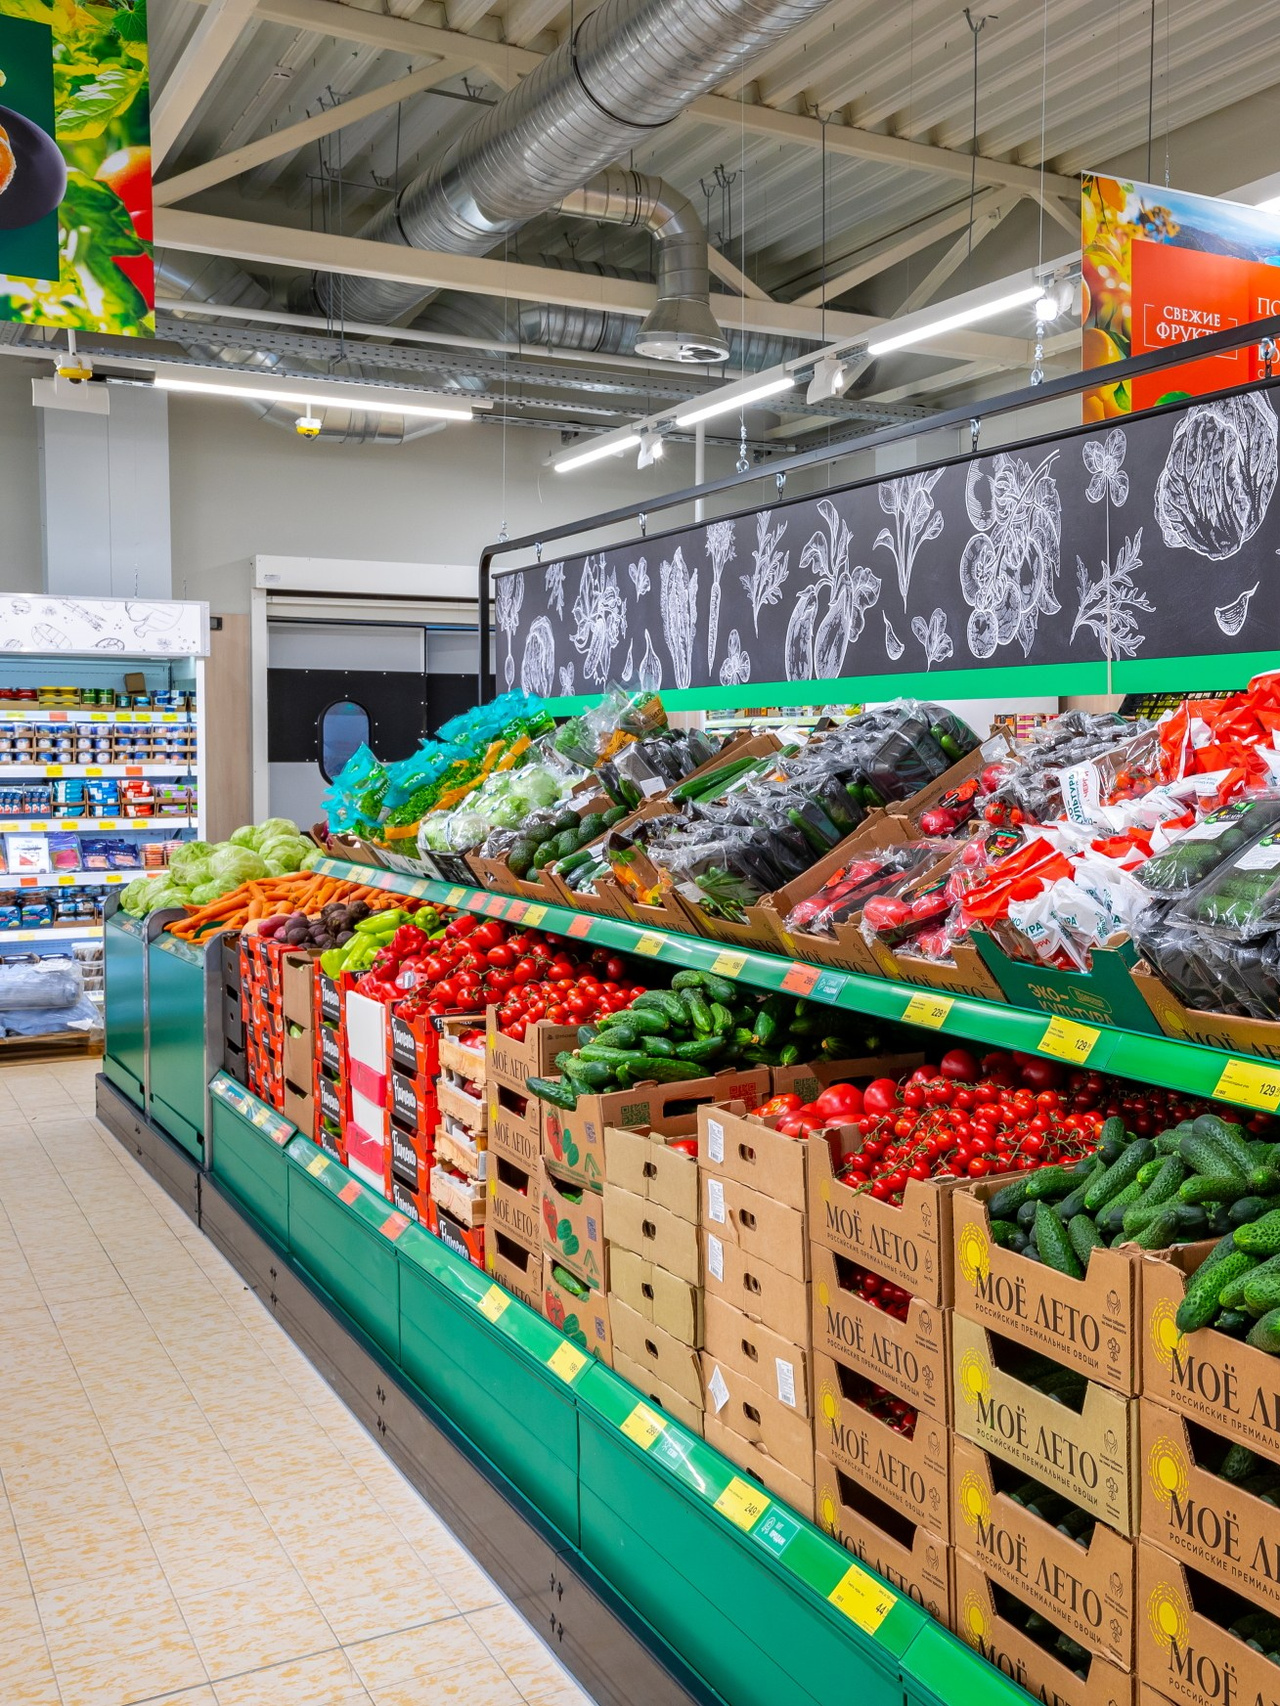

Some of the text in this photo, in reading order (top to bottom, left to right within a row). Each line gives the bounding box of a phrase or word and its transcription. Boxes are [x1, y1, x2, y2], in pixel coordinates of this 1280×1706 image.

[1156, 322, 1219, 343] ФРУК
[1163, 306, 1221, 327] СВЕЖИЕ
[502, 718, 522, 736] РОСТ
[526, 710, 547, 727] РОСТ
[1027, 982, 1069, 1000] ЭКО-
[930, 1007, 944, 1018] 229
[490, 1048, 530, 1080] МОЁ ЛЕТО
[1075, 1038, 1088, 1051] 129
[1260, 1083, 1276, 1097] 129
[493, 1118, 511, 1145] МОЁ
[512, 1132, 531, 1160] ЛЕТО
[492, 1194, 510, 1221] МОЁ
[511, 1208, 533, 1237] ЛЕТО
[825, 1200, 918, 1272] МОЁ ЛЕТО
[975, 1266, 1100, 1352] МОЁ ЛЕТО
[826, 1304, 919, 1384] МОЁ ЛЕТО
[975, 1302, 1100, 1370] РОССИЙСКИЕ ПРЕМИАЛЬНЫЕ ОВОЩИ
[1169, 1345, 1240, 1415] МОЁ
[1170, 1389, 1229, 1425] РОССИЙСКИЕ
[830, 1416, 926, 1505] МОЁ ЛЕТО
[976, 1391, 1099, 1490] МОЁ ЛЕТО
[976, 1427, 1020, 1462] РОССИЙСКИЕ
[1021, 1453, 1071, 1488] ПРЕМИАЛЬНЫЕ
[1072, 1482, 1099, 1507] ОВОЩИ
[744, 1502, 758, 1516] 249
[1169, 1489, 1241, 1562] МОЁ
[976, 1514, 1029, 1569] МОЁ
[1036, 1555, 1102, 1629] ЛЕТО
[1169, 1532, 1228, 1573] РОССИЙСКИЕ
[875, 1602, 888, 1616] 44
[976, 1549, 1020, 1586] РОССИЙСКИЕ
[1020, 1580, 1072, 1621] ПРЕМИАЛЬНЫЕ
[1073, 1618, 1102, 1646] ОВОЩИ
[1168, 1634, 1238, 1706] МОЁ
[1169, 1677, 1214, 1706] РОССИЙС
